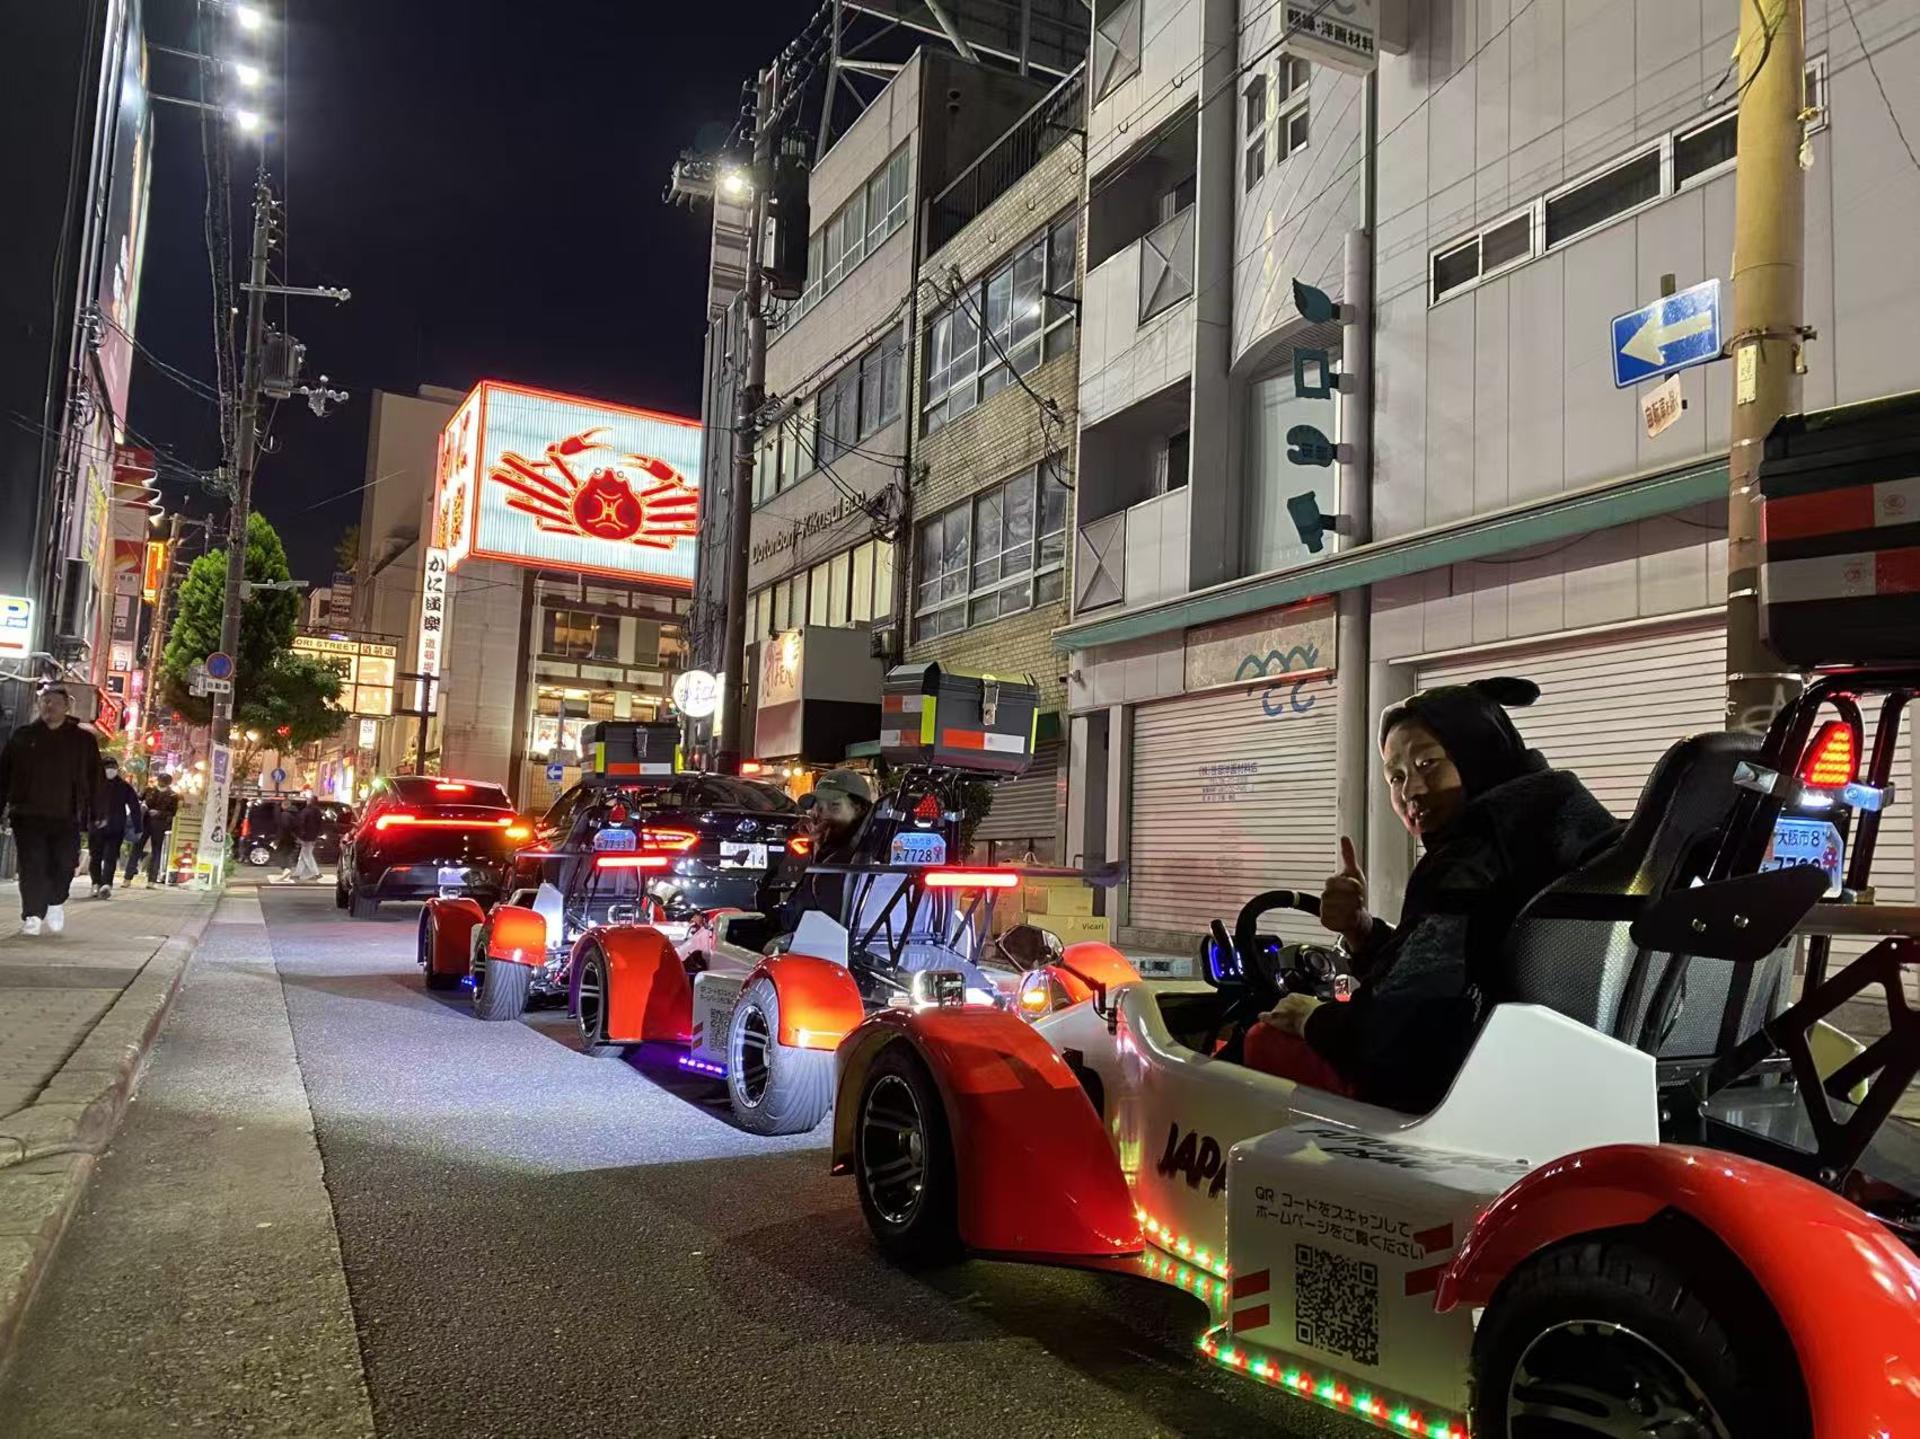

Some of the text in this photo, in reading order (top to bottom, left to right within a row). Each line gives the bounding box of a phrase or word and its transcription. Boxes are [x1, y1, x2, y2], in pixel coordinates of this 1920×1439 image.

[316, 641, 357, 651] STREET
[904, 848, 933, 863] 7728
[1255, 1185, 1411, 1238] QR コードをスキャンして
[1255, 1205, 1425, 1261] ホームページをご覧ください
